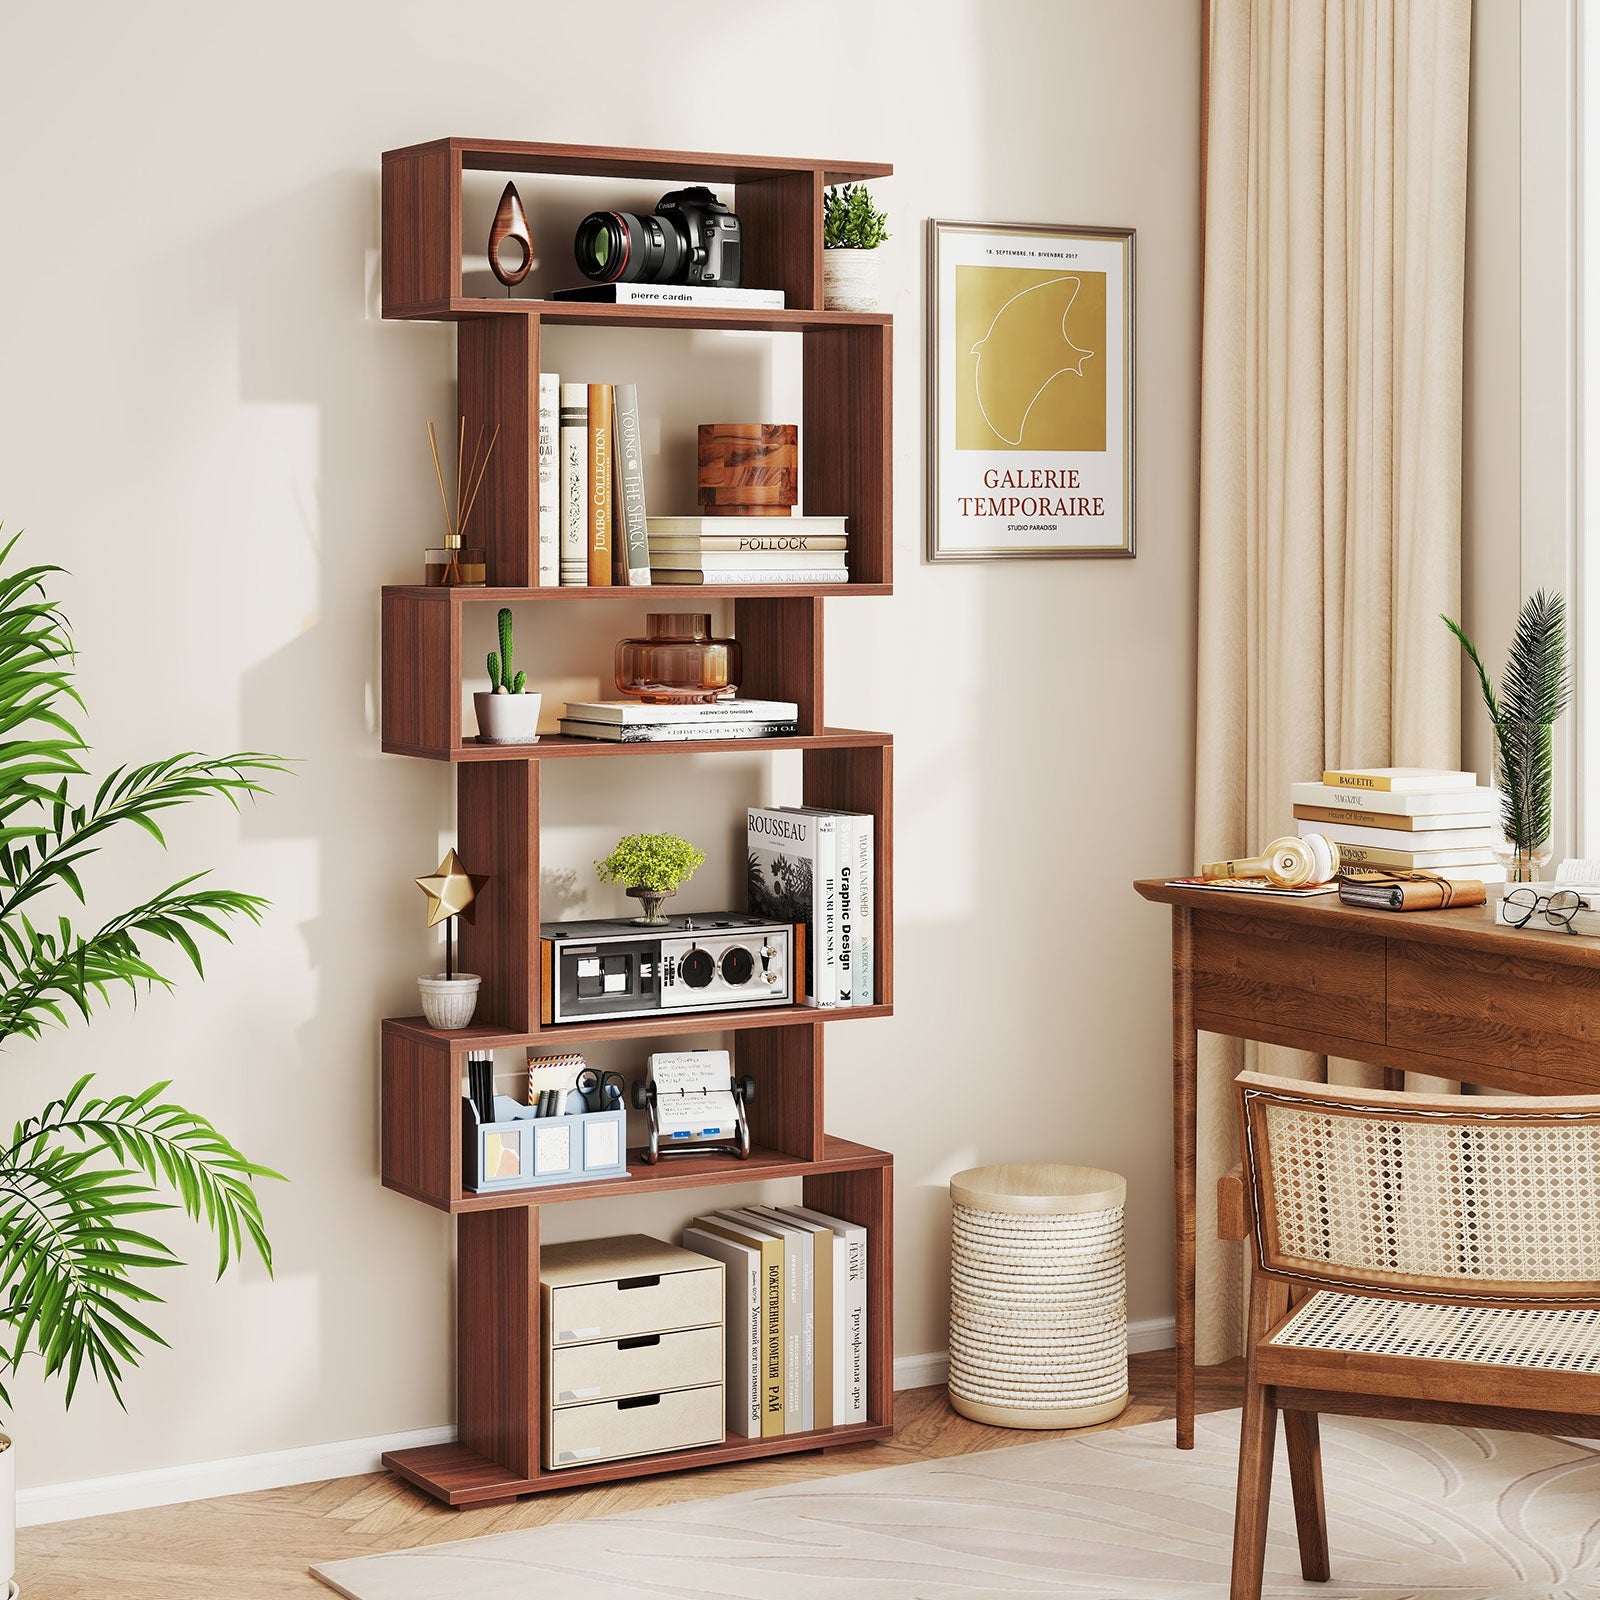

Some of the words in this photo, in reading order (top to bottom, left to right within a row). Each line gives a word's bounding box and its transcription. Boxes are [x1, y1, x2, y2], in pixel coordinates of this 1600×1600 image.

[631, 291, 660, 300] pierre
[662, 292, 693, 302] cardin
[622, 408, 637, 459] YOUNG
[593, 427, 606, 506] COLLECTION
[983, 468, 1081, 489] GALERIE
[625, 472, 641, 502] THE
[957, 496, 1105, 517] TEMPORAIRE
[593, 509, 609, 552] JUMBO
[627, 504, 645, 551] SHACK
[739, 537, 808, 550] POLLOCK
[1339, 776, 1375, 787] BAGUETTE
[748, 814, 807, 842] ROUSSEAU
[1328, 811, 1345, 820] House
[1345, 812, 1353, 820] Of
[1340, 845, 1368, 861] Voyage
[826, 878, 834, 911] HENRI
[838, 866, 852, 920] Graphic
[826, 914, 834, 969] ROUSSEAU
[839, 924, 852, 971] Design
[769, 1265, 779, 1334] БОЖЕСТВЕННАЯ
[752, 1306, 760, 1345] Уличный
[769, 1336, 779, 1379] КОМЕДИЯ
[851, 1306, 862, 1383] Триумфальная
[752, 1363, 758, 1374] по
[751, 1403, 760, 1421] Боб
[768, 1385, 782, 1412] РАЙ
[851, 1386, 861, 1410] арка
